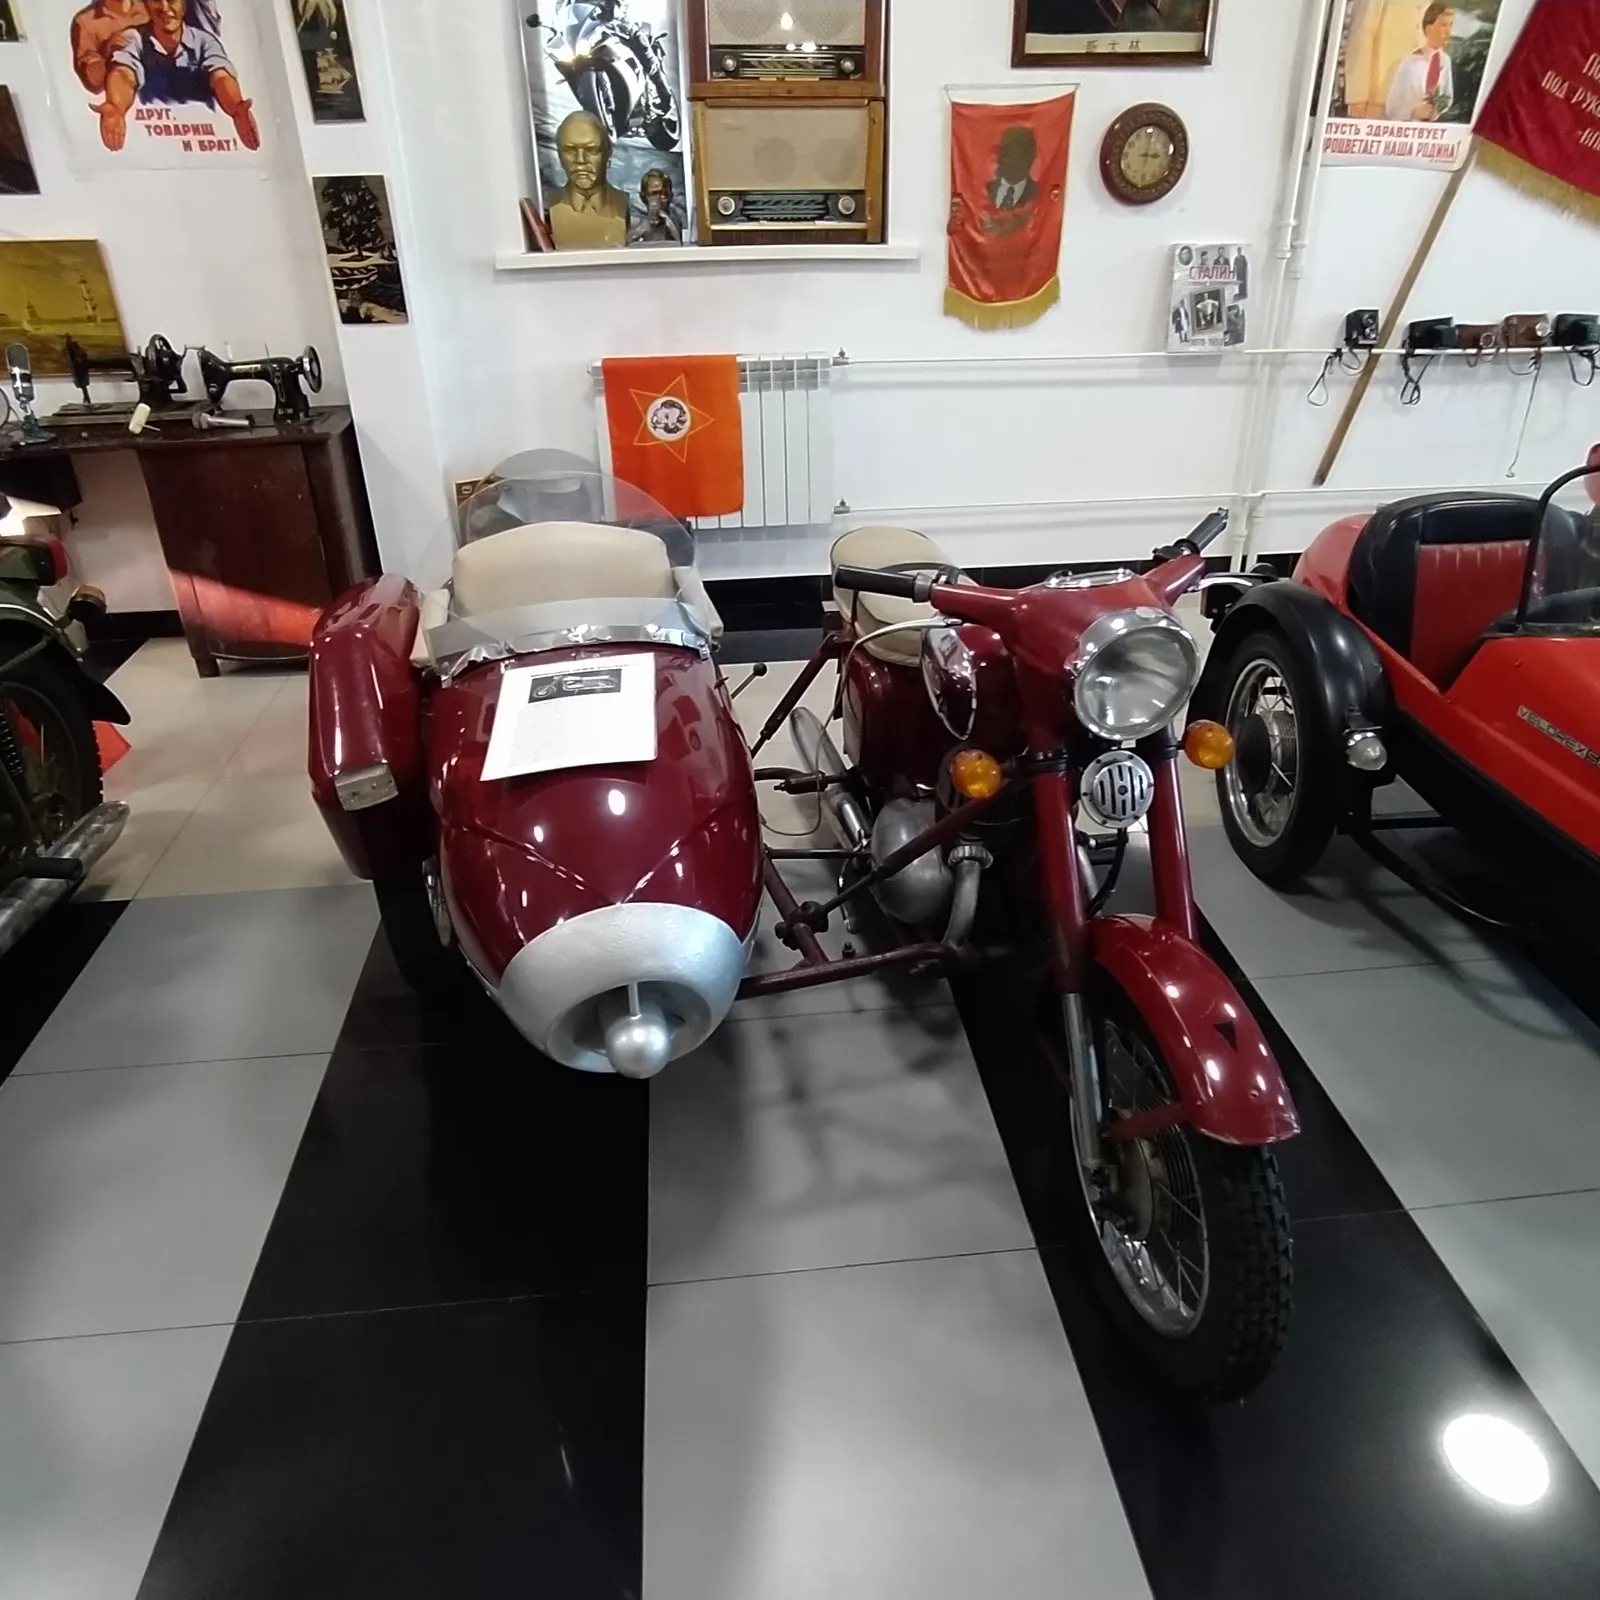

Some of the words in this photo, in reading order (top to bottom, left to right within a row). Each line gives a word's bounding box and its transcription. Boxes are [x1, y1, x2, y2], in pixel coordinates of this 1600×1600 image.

[1541, 70, 1570, 99] ПОД
[144, 123, 216, 137] ТОВАРИЩ
[1325, 122, 1361, 136] ПУСТЬ
[1365, 124, 1447, 141] ЗДРАВСТВУЕТ
[181, 140, 192, 152] И
[198, 138, 238, 152] БРАТ!
[1383, 140, 1413, 157] НАША
[1189, 264, 1236, 280] СТАЛИН
